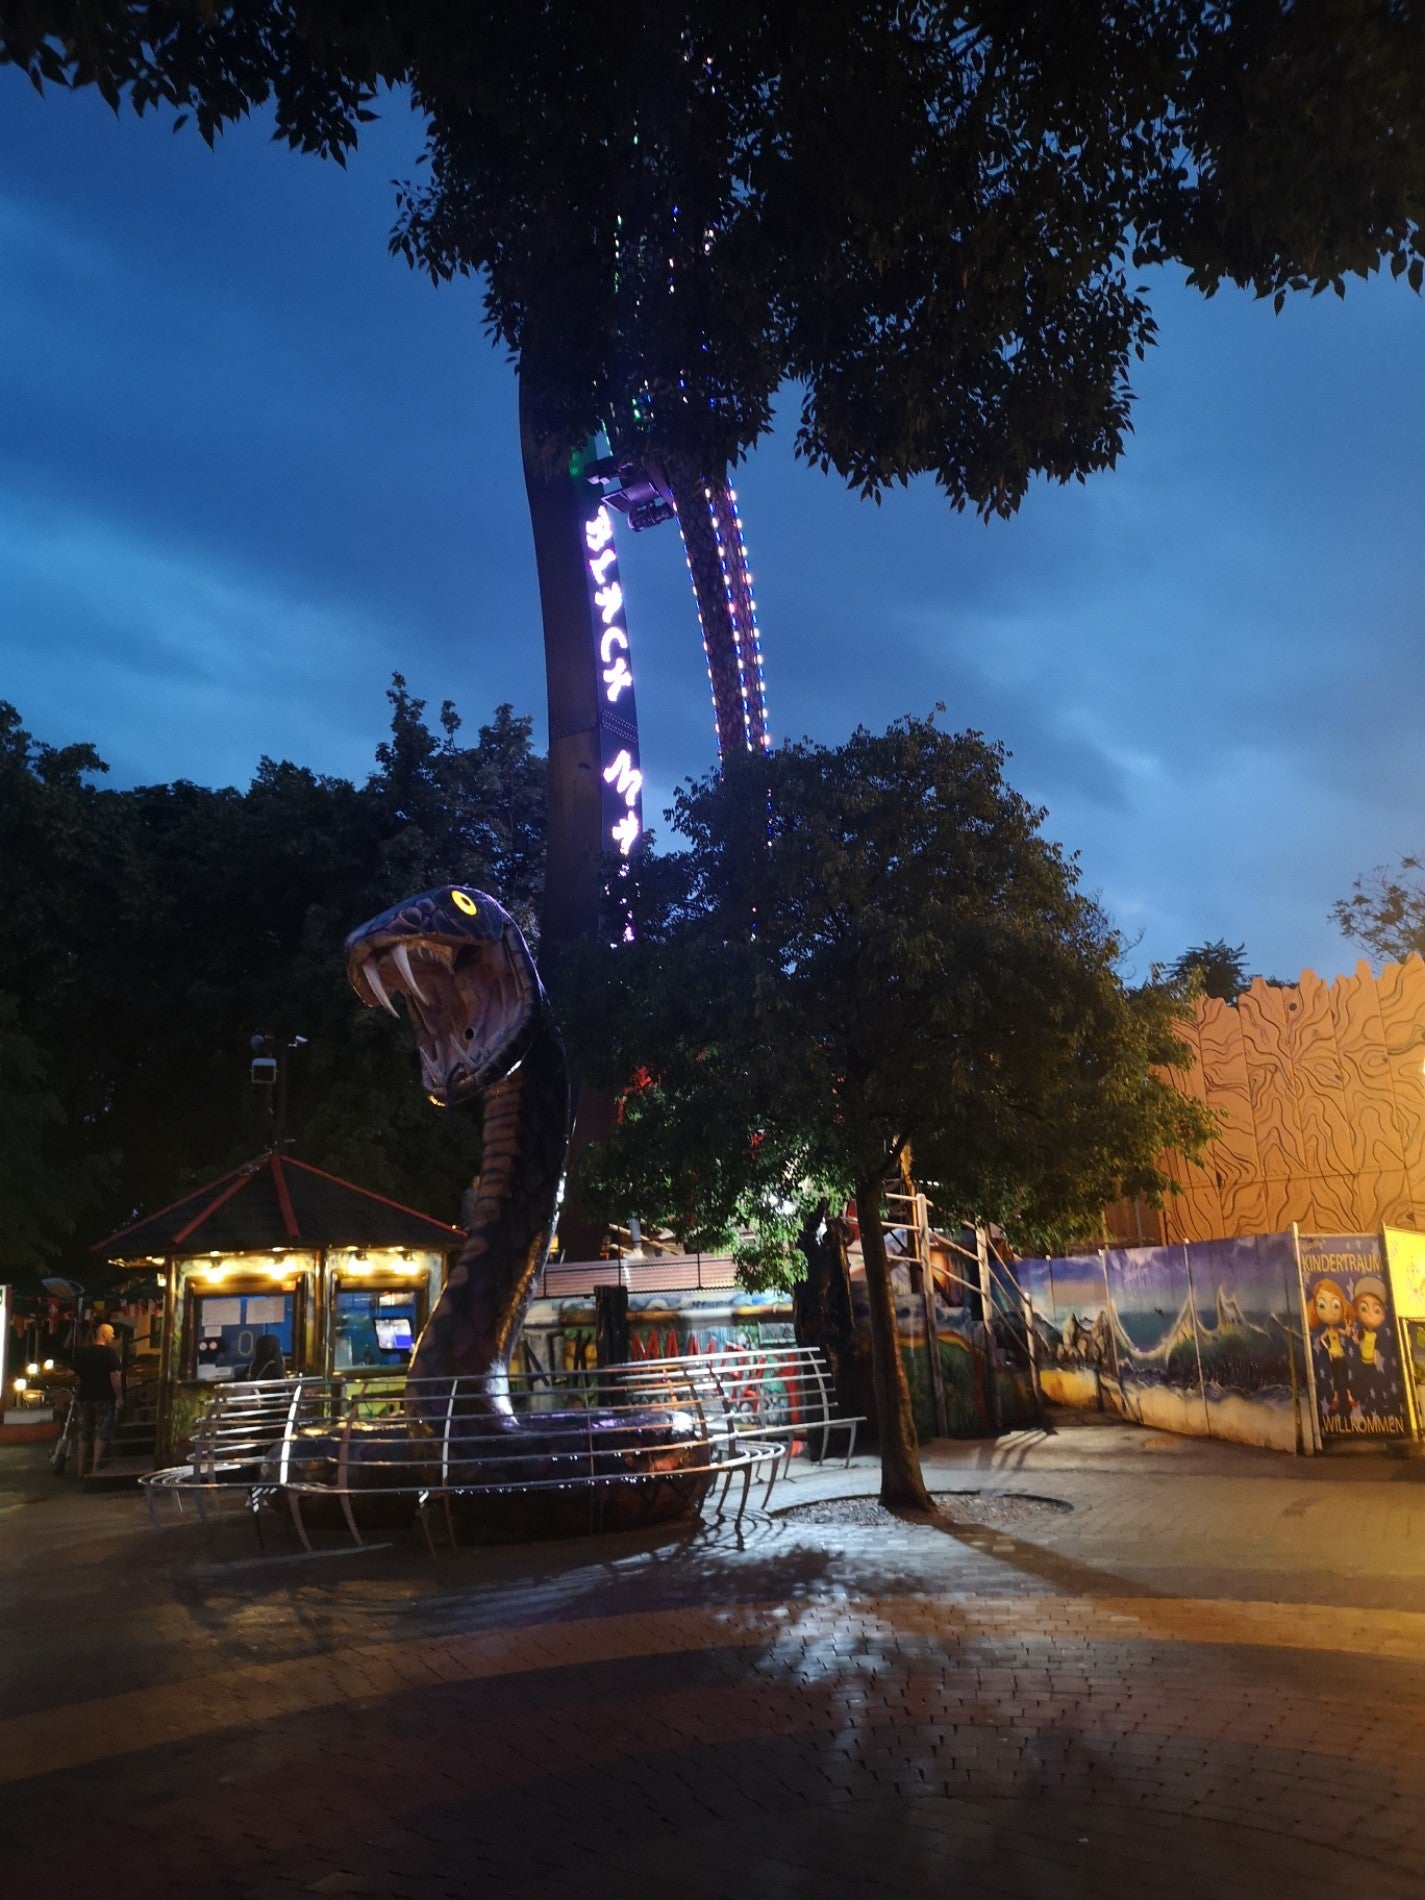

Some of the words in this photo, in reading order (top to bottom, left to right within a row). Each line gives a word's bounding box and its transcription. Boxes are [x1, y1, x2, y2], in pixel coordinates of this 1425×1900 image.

[584, 504, 634, 704] BLACK
[1302, 1253, 1384, 1273] KINDERTRAUM
[1322, 1414, 1404, 1433] WILLKOMMEN
